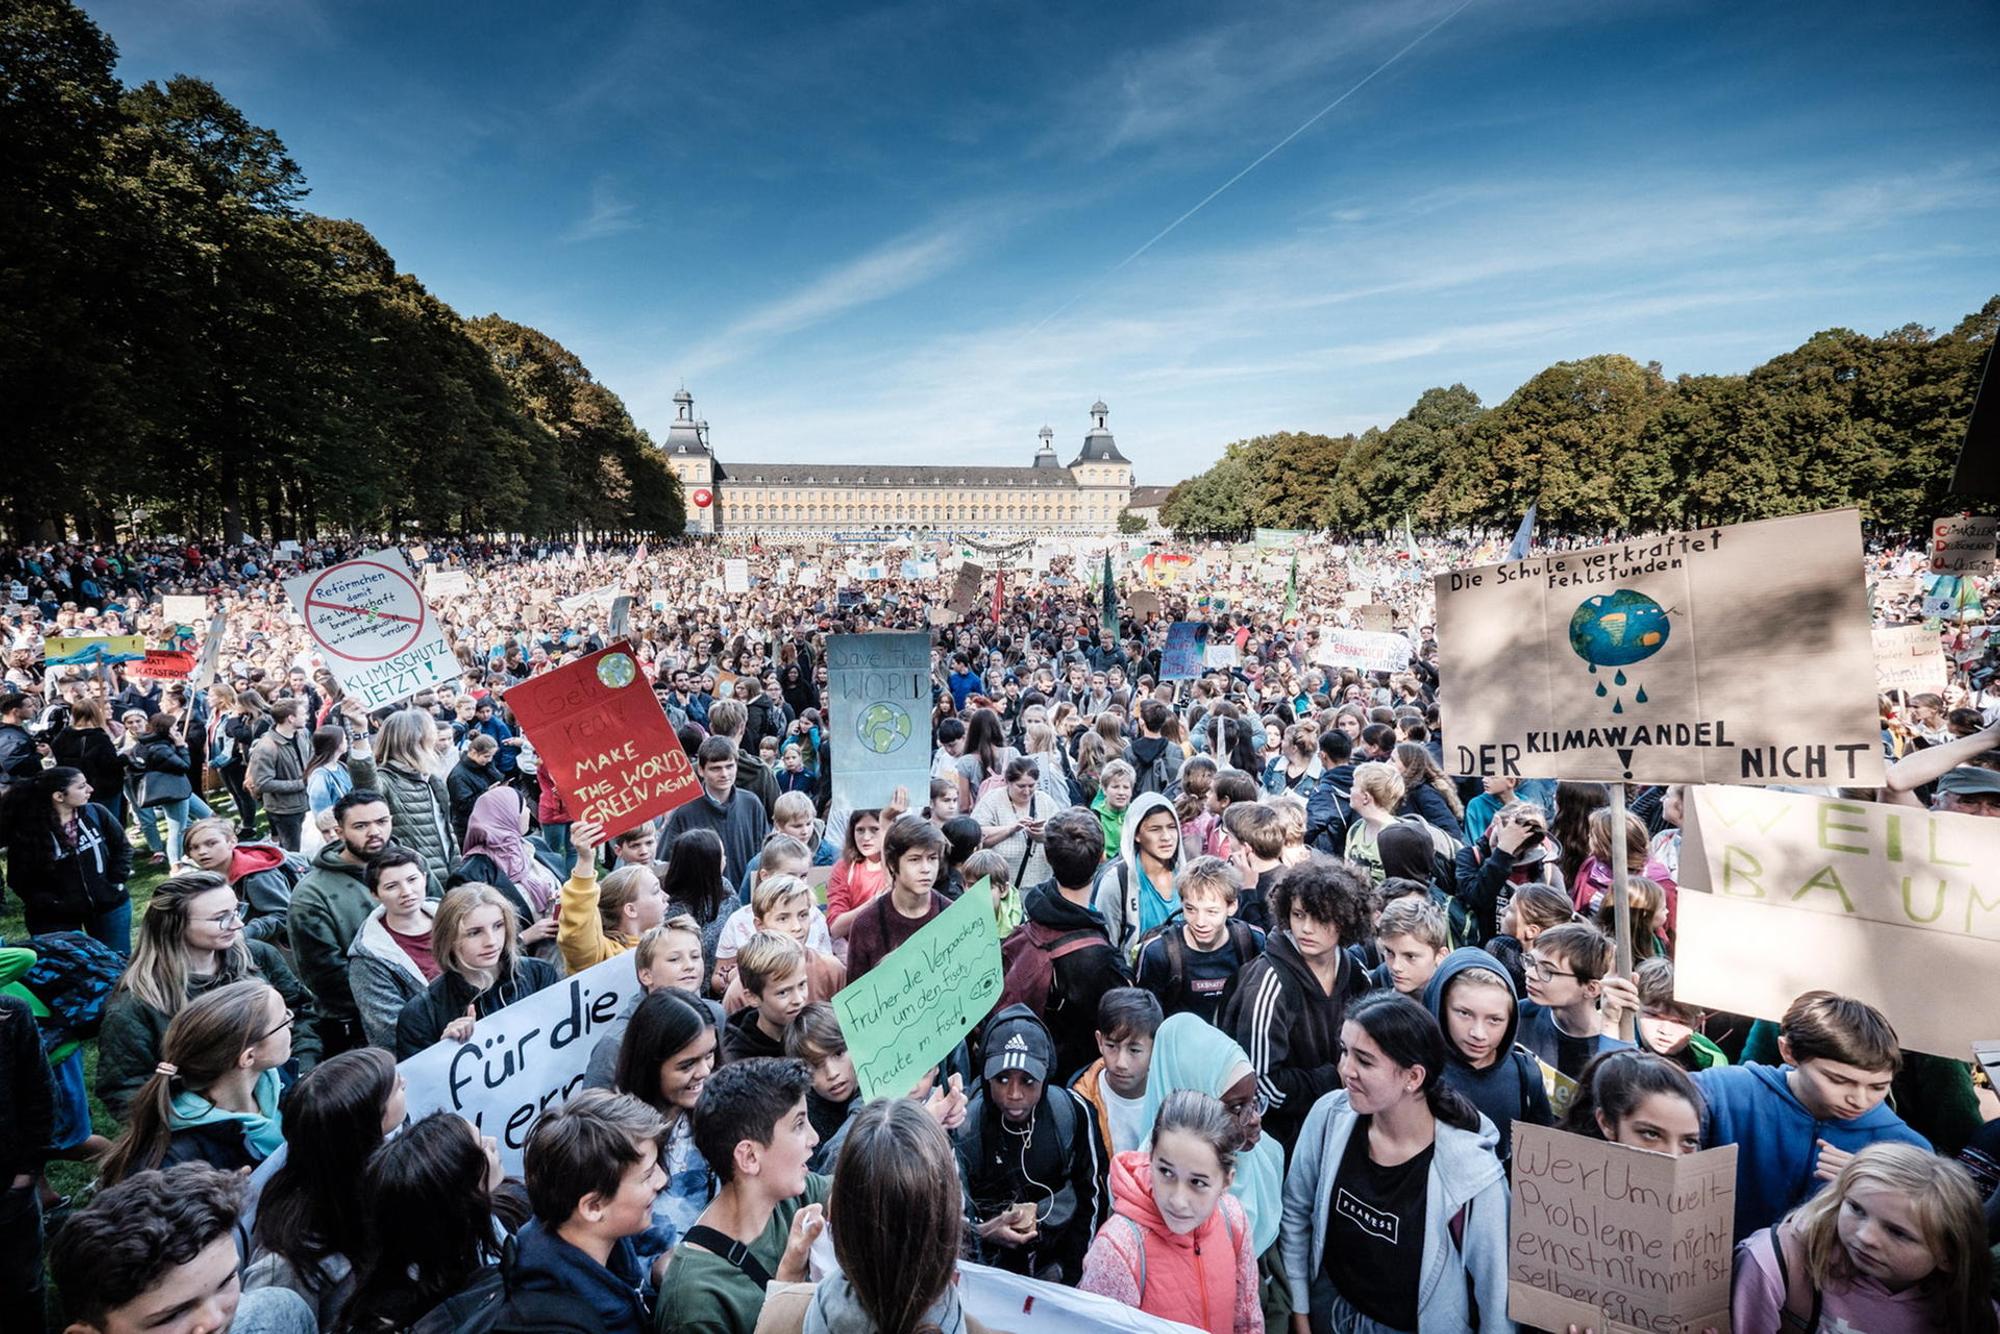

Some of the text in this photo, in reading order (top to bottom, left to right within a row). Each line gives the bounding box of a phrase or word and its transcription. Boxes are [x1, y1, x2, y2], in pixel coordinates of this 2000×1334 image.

[1451, 529, 1722, 591] Die Schule verkraftet
[1549, 557, 1683, 590] Fehlstunden
[315, 572, 386, 598] Reförmchen
[333, 592, 396, 618] Wirtschaft
[346, 587, 373, 602] damit
[329, 613, 362, 630] brummt
[344, 639, 448, 692] KLIMASCHUTZ
[834, 643, 880, 667] Save
[829, 672, 931, 701] WORLD
[576, 739, 640, 780] MAKE
[1457, 720, 1736, 777] DER KLIMAWANDEL
[1741, 743, 1871, 778] NICHT
[573, 749, 689, 802] THE WORLD
[580, 782, 649, 824] GREEN
[1702, 793, 1971, 867] WEIL
[903, 968, 924, 995] die
[922, 917, 986, 973] Verpackung
[550, 979, 619, 1050] die
[892, 1003, 917, 1026] um
[917, 985, 941, 1009] den
[1004, 1043, 1029, 1051] adidas
[863, 1053, 913, 1096] heute
[1516, 1134, 1599, 1191] Wer
[1518, 1180, 1728, 1262] Probleme nicht
[1702, 1257, 1729, 1281] ist
